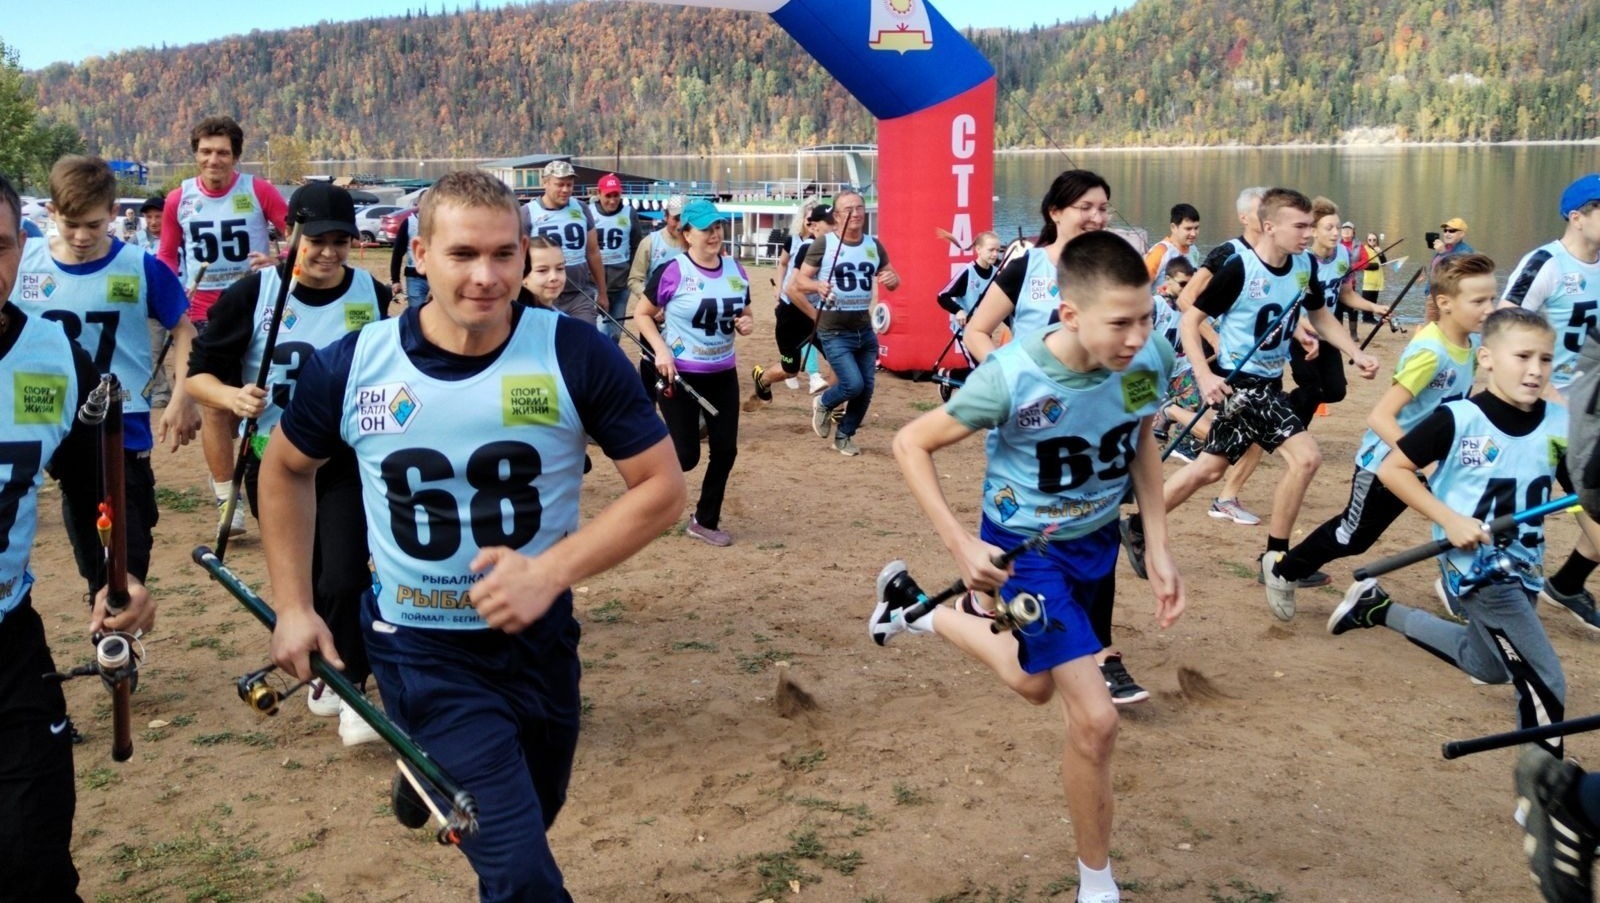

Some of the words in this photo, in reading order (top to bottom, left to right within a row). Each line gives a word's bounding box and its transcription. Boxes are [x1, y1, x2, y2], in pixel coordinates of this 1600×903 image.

[189, 218, 250, 263] 55
[538, 223, 585, 250] 59
[23, 275, 39, 284] РЫ
[835, 261, 875, 292] 63
[23, 290, 39, 299] ОН
[692, 297, 744, 336] 45
[360, 388, 386, 405] РЫ
[511, 387, 541, 396] СПОРТ
[511, 396, 549, 405] НОРМА
[360, 404, 386, 415] БАТЛ
[512, 405, 550, 416] ЖИЗНИ
[361, 415, 385, 431] ОН
[1019, 415, 1041, 427] ОН
[1462, 439, 1480, 449] РЫ
[1036, 420, 1140, 494] 69
[1462, 456, 1481, 466] ОН
[381, 440, 543, 561] 68
[401, 612, 445, 622] ПОЙМАЛ
